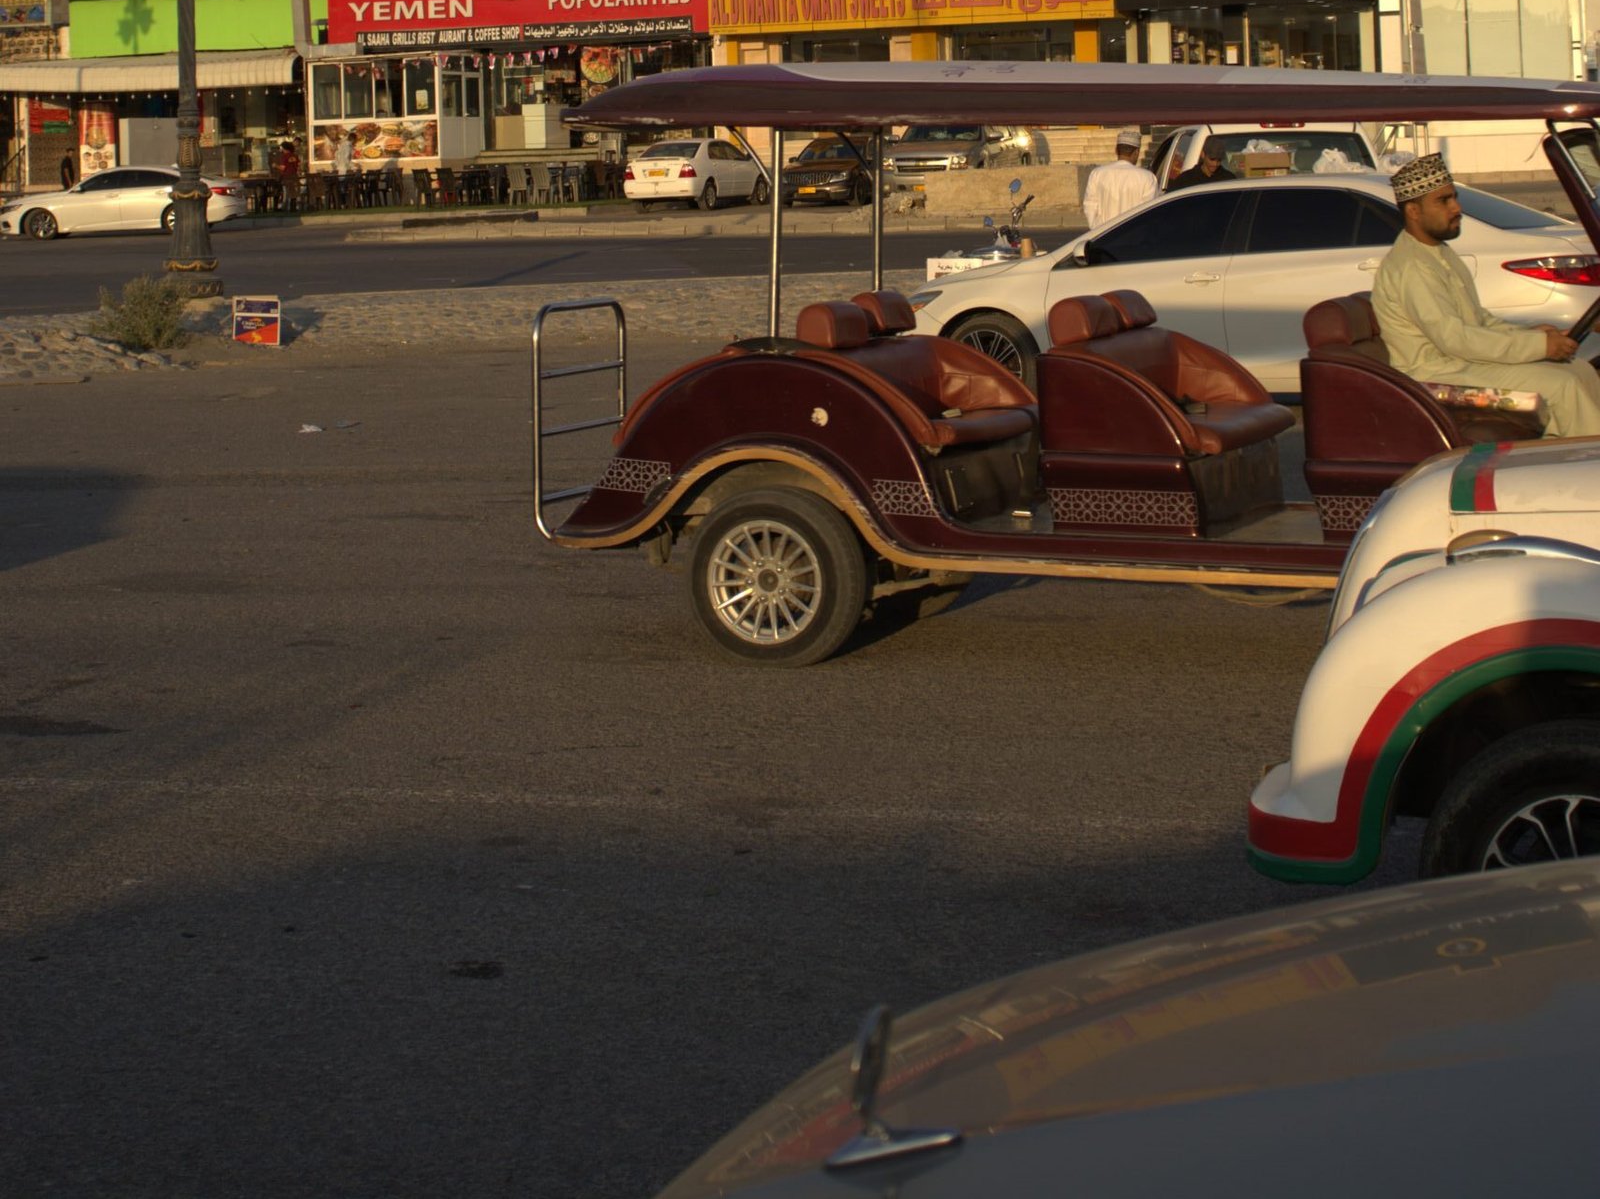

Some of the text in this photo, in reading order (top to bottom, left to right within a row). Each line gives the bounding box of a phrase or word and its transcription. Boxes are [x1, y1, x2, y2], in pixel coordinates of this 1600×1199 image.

[366, 32, 390, 46] SAAHA
[392, 31, 416, 45] GRILLS
[467, 29, 474, 42] &
[475, 27, 501, 41] COFFEE
[501, 25, 521, 40] SHOP
